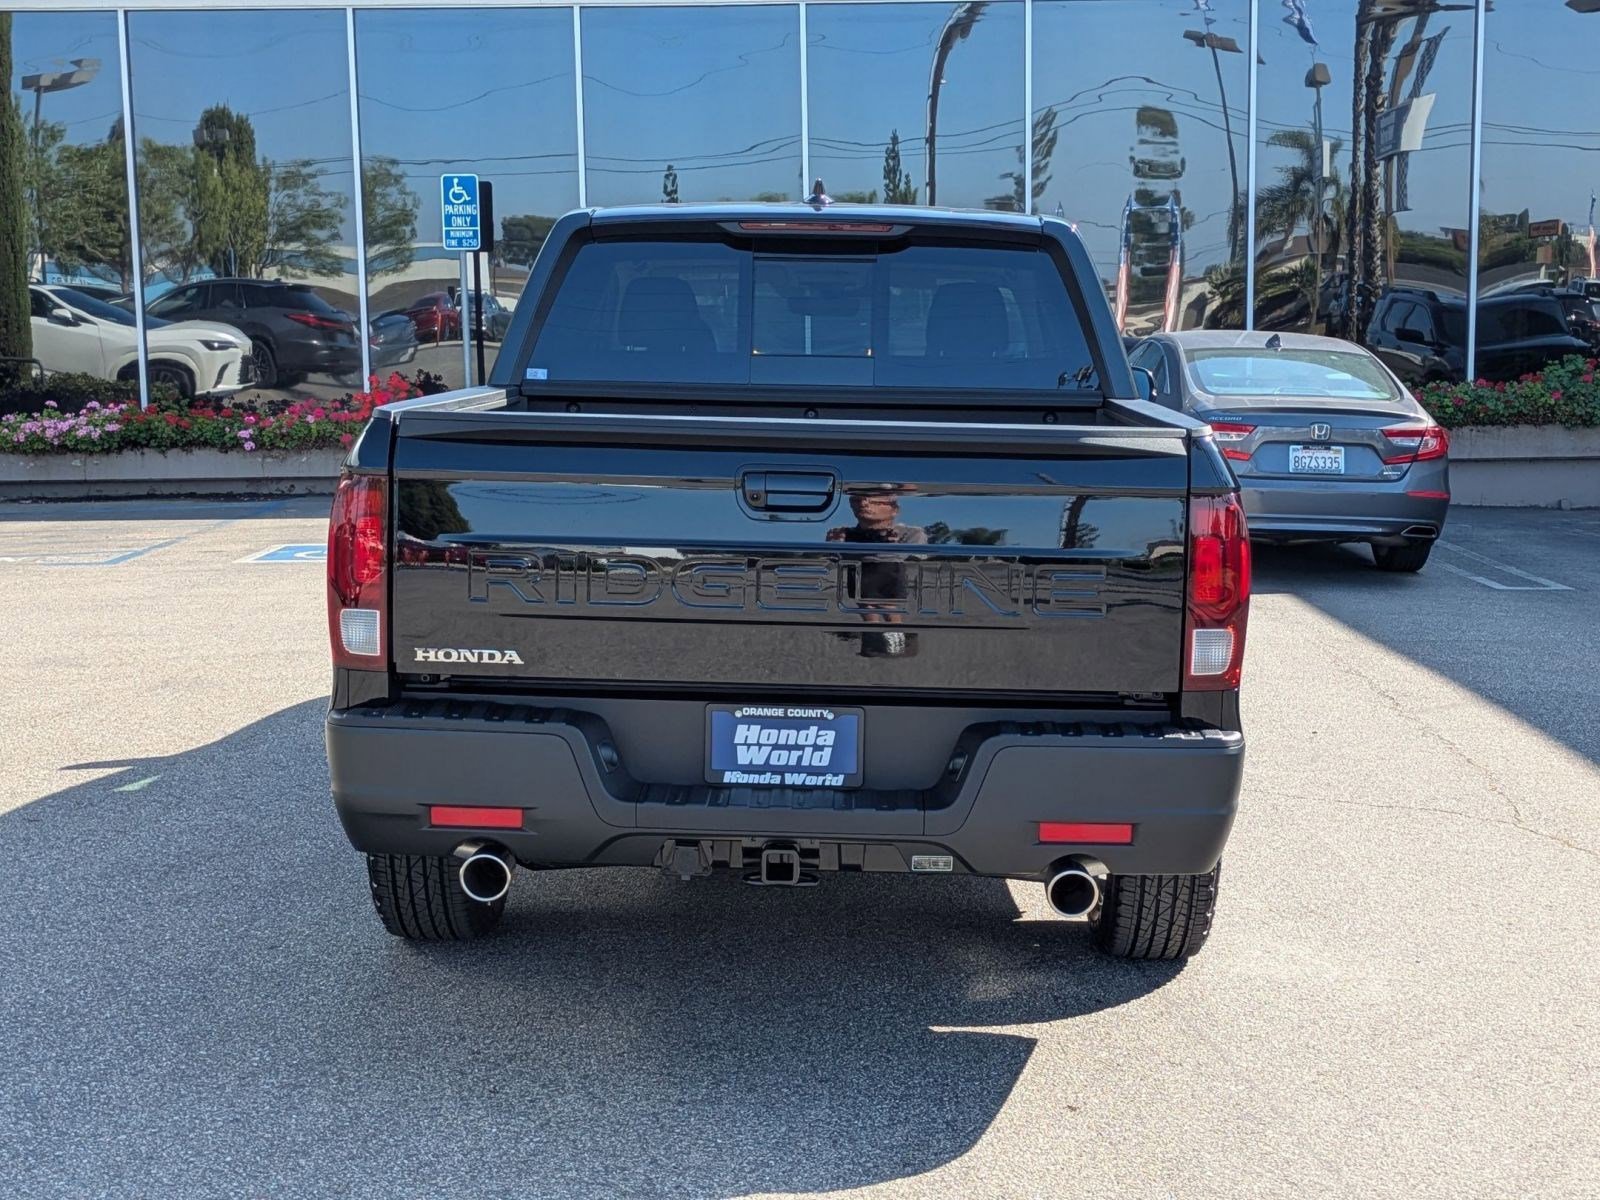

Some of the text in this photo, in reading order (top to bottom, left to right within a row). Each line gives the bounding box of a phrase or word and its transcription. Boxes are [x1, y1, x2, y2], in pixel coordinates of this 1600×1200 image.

[445, 204, 477, 215] PARKING
[451, 216, 471, 227] ONLY
[450, 230, 473, 238] MINIMUM
[447, 239, 478, 247] FINE $250
[1293, 455, 1341, 469] 8GZS335
[468, 550, 1107, 619] RIDGELINE
[414, 647, 525, 665] HONDA
[742, 707, 829, 718] ORANGE COUNTY
[733, 724, 836, 746] Honda
[736, 745, 833, 767] World
[723, 771, 845, 787] Honda World
